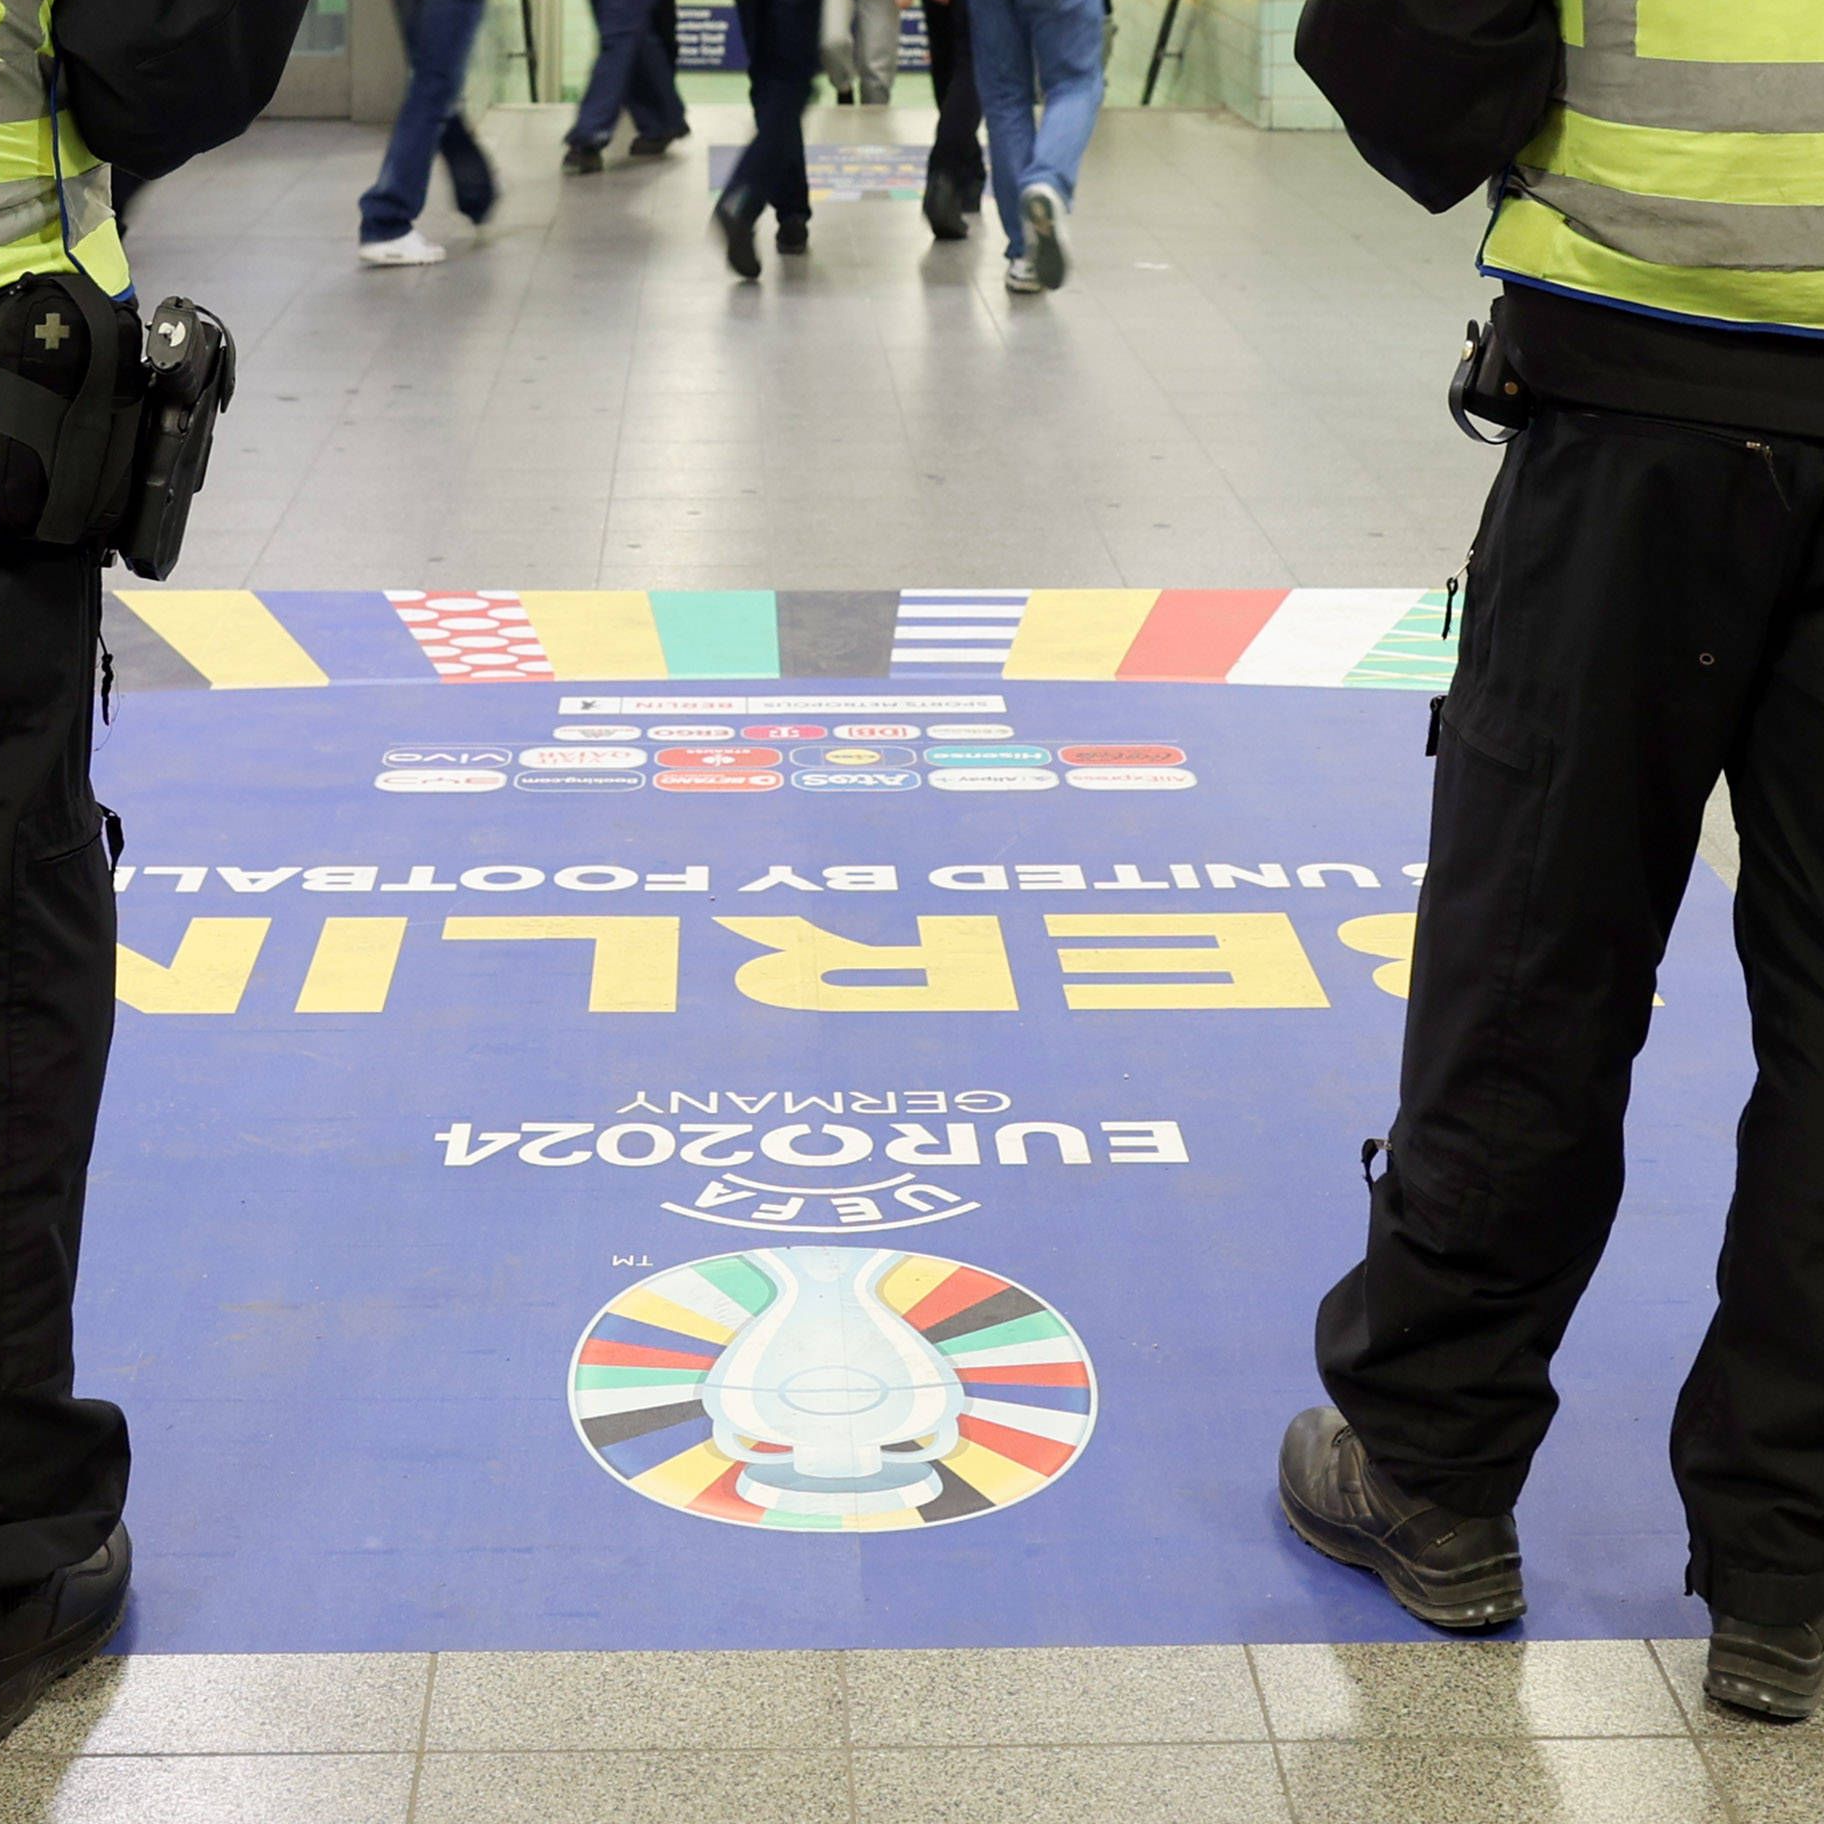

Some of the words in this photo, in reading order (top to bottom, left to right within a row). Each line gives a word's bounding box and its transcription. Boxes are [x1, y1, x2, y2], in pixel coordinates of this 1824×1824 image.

[653, 729, 729, 737] ERGO
[387, 753, 506, 764] vivo
[932, 752, 1043, 760] Hisense
[521, 776, 639, 784] Booking.com
[661, 776, 746, 784] BETANO
[1073, 774, 1187, 783] AliExpress
[738, 865, 898, 892] BY
[928, 863, 1381, 891] UNITED
[616, 1090, 1011, 1113] GERMANY
[435, 1121, 1189, 1166] EURO2024
[694, 1180, 962, 1224] UEFA
